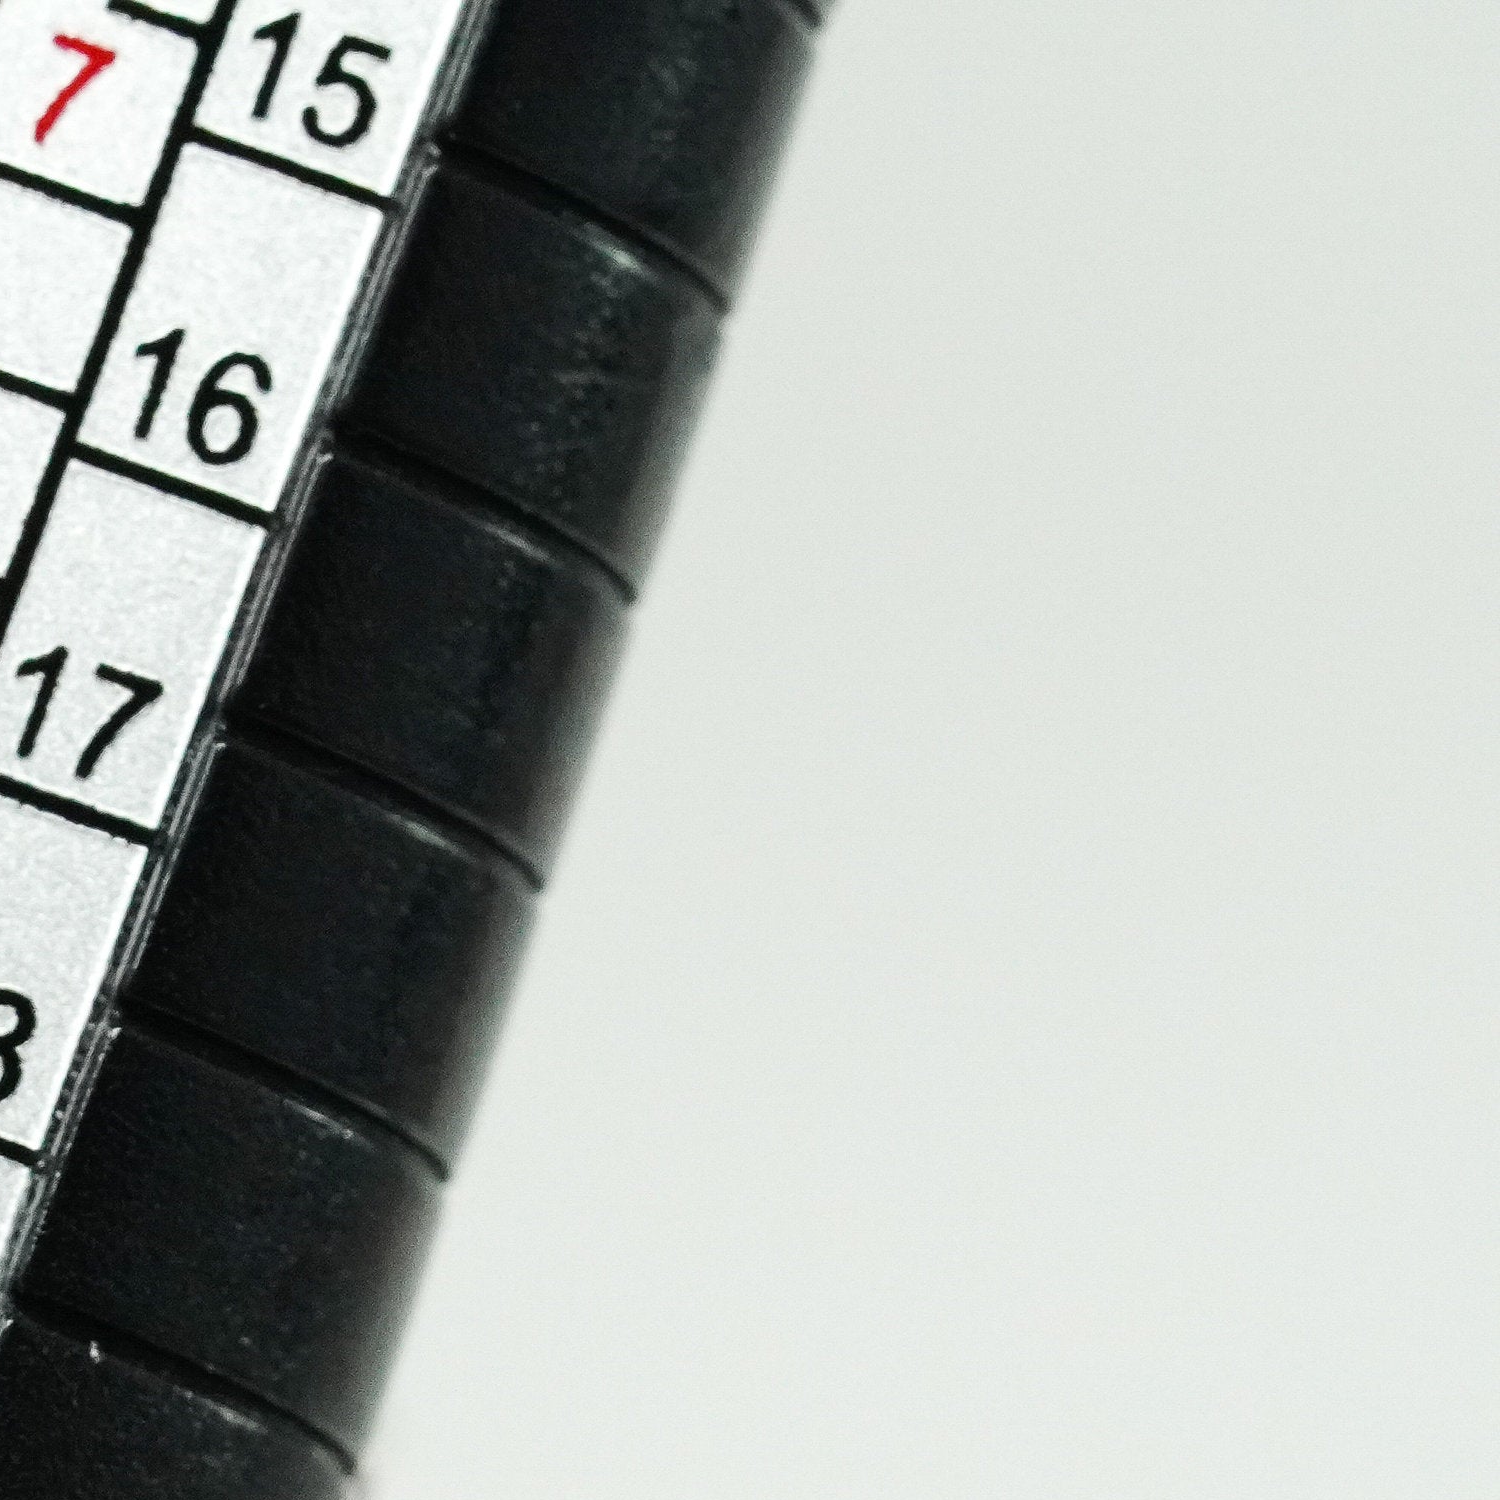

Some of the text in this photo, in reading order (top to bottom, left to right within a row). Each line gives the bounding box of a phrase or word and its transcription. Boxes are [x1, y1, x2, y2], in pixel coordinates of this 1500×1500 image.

[35, 33, 118, 144] 7
[251, 11, 392, 150] 15
[133, 327, 273, 467] 16
[15, 644, 165, 780] 17
